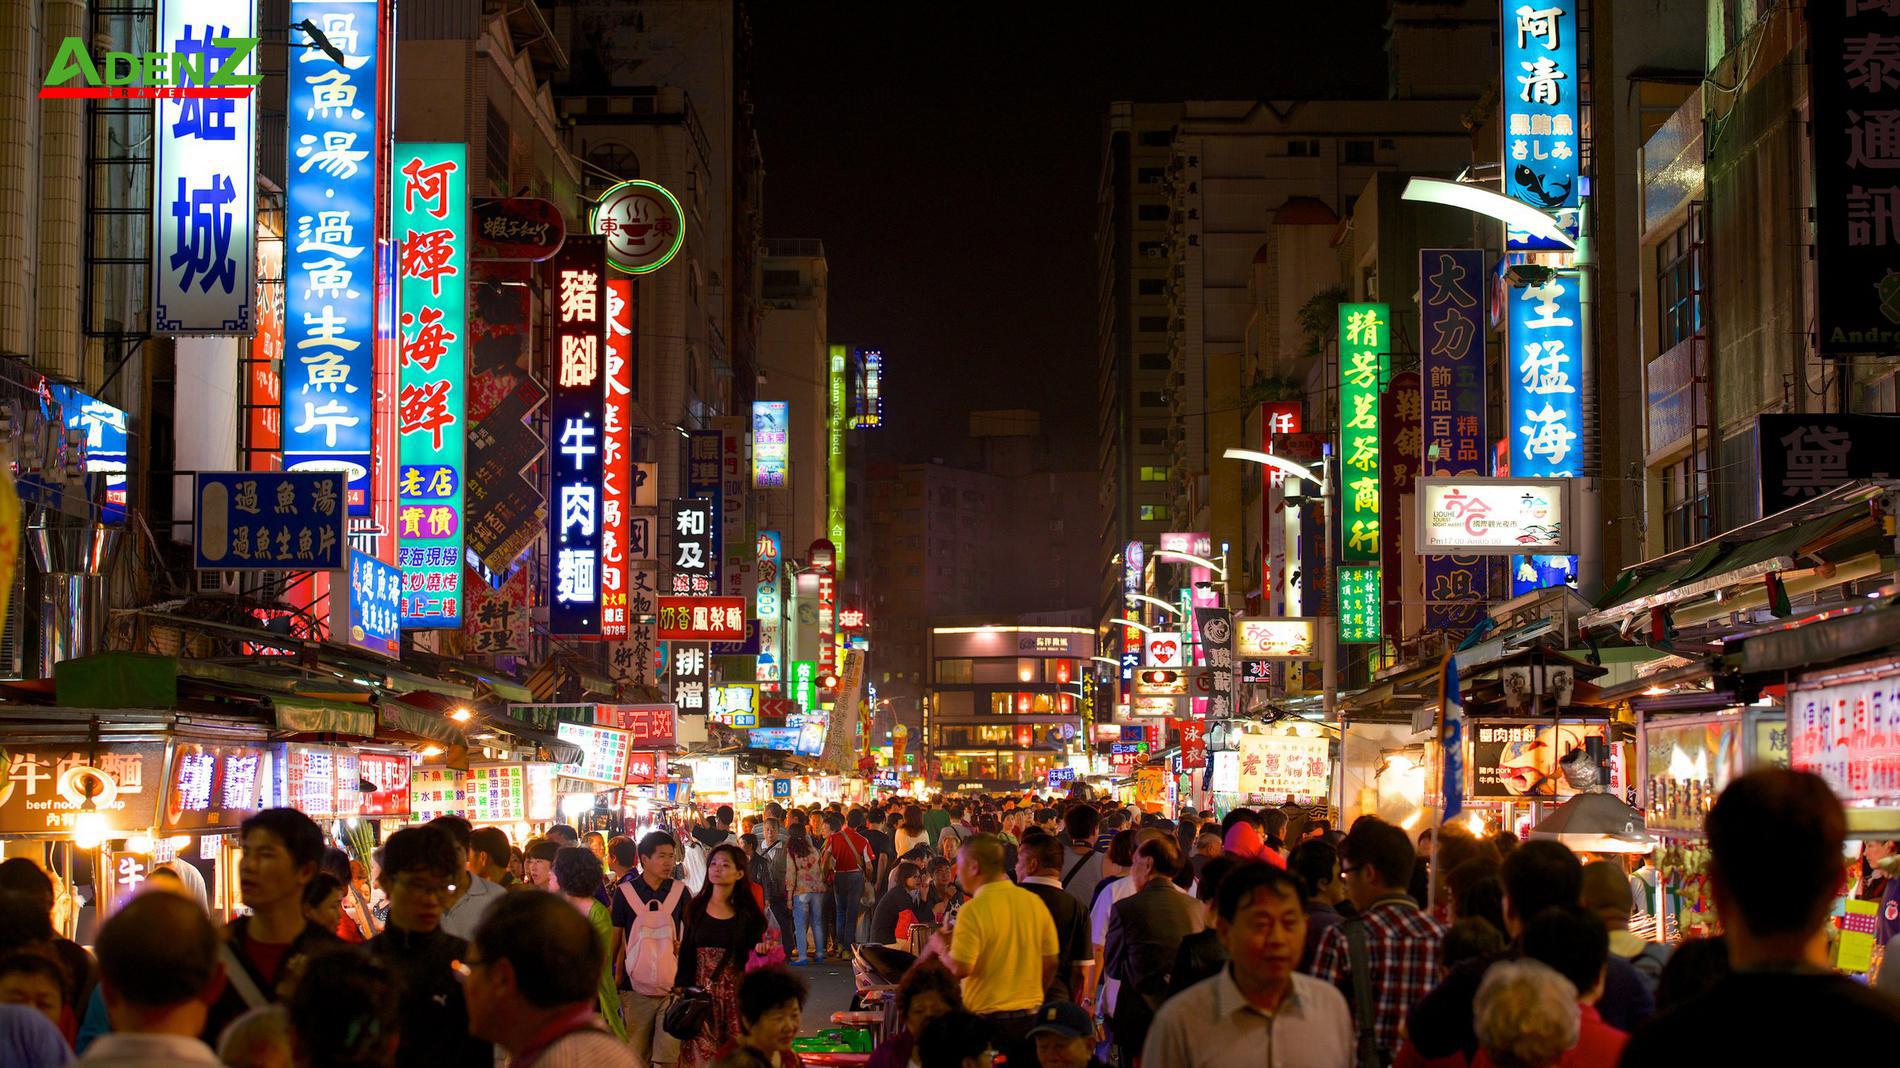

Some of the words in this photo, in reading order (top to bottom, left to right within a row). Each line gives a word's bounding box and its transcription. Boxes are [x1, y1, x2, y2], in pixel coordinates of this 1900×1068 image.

[1516, 5, 1565, 106] 阿清
[1510, 114, 1573, 135] 黑鮪魚
[1511, 140, 1573, 160] さしみ
[401, 157, 457, 450] 阿輝海鮮
[1428, 254, 1477, 360] 大力
[561, 270, 598, 388] 豬腳
[1520, 279, 1577, 477] 生猛海
[831, 377, 842, 426] Sunnyside
[832, 428, 842, 455] Hotel
[234, 479, 338, 515] 過魚湯
[400, 467, 452, 497] 老店
[400, 507, 452, 538] 實價
[559, 418, 596, 603] 牛肉麵
[232, 523, 338, 563] 過魚生魚片
[477, 599, 518, 652] 料理
[603, 625, 627, 636] 1978年
[659, 605, 742, 632] 奶香鳳梨酥
[676, 648, 705, 710] 排檔
[1112, 754, 1136, 764] 果汁
[1184, 726, 1202, 764] 泳衣
[776, 781, 788, 793] 50
[1496, 767, 1512, 775] pork
[26, 799, 52, 810] beef
[118, 857, 145, 892] 牛
